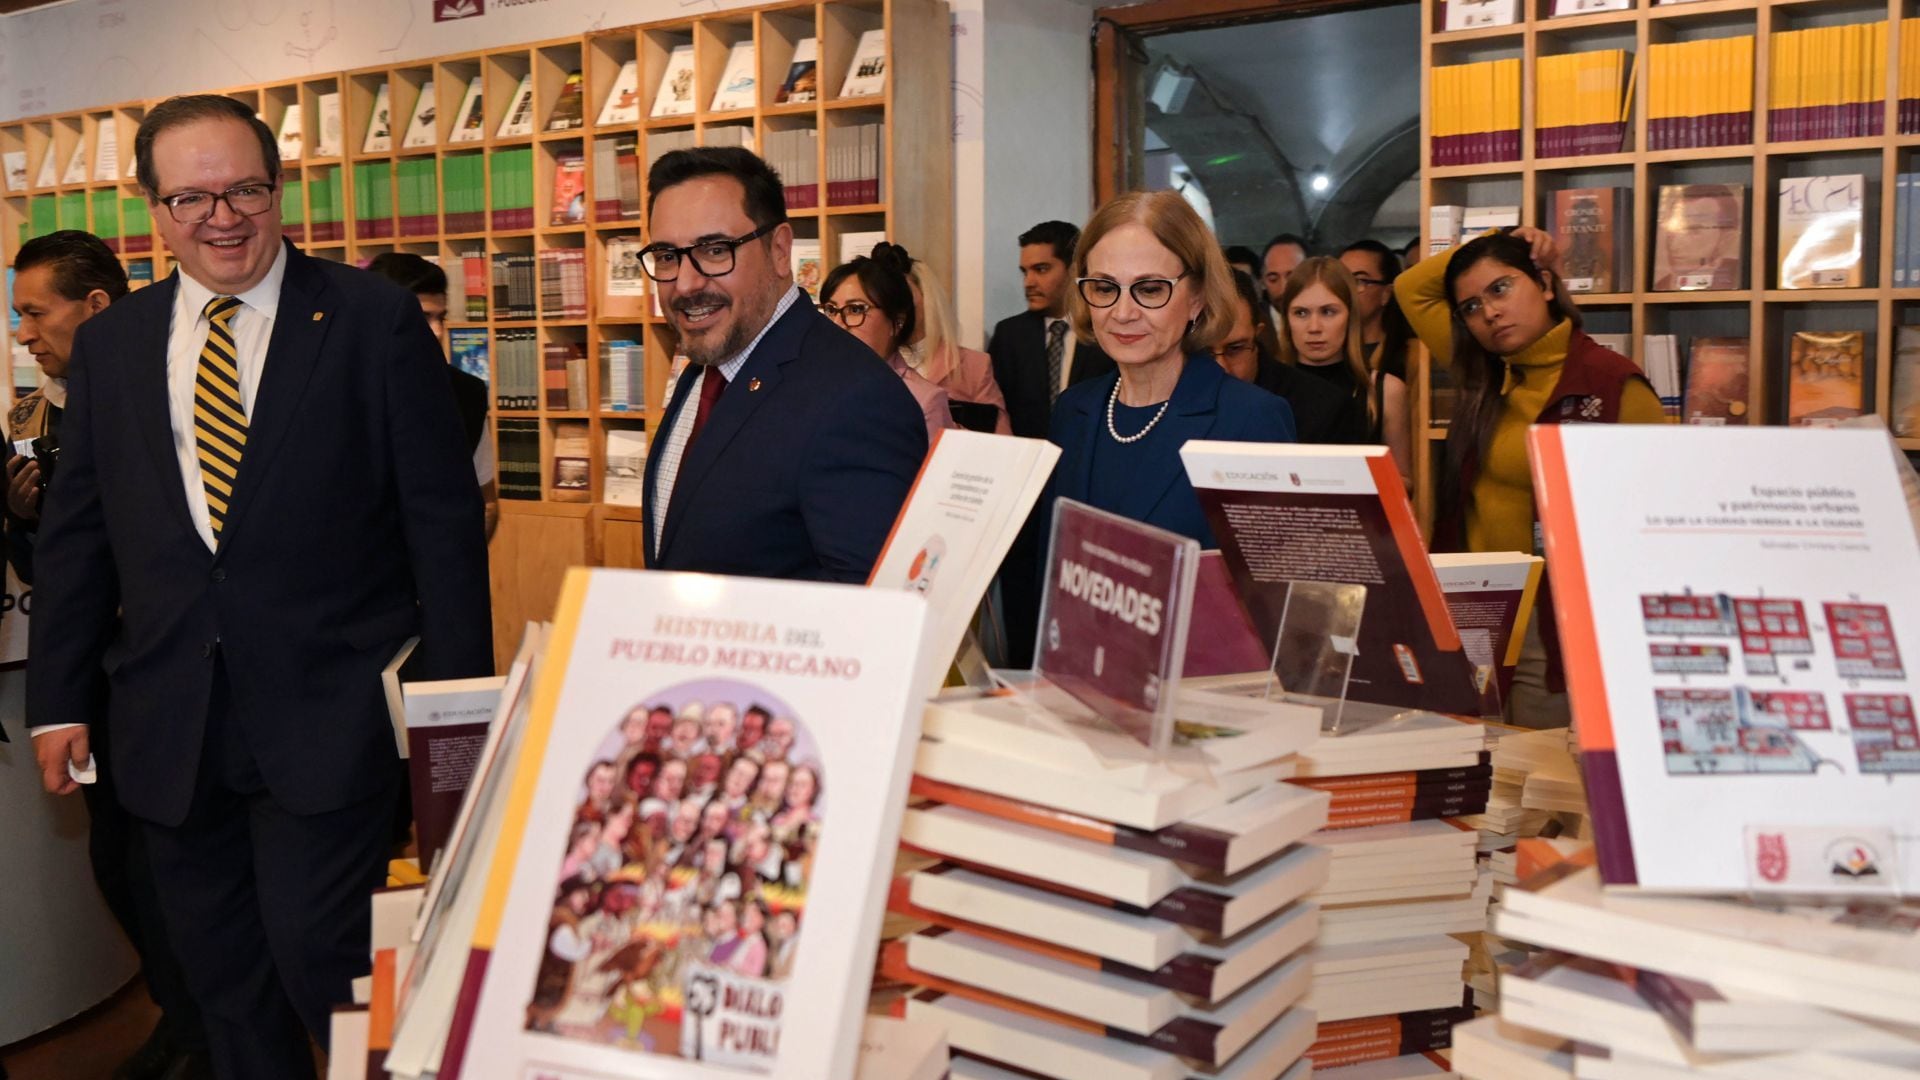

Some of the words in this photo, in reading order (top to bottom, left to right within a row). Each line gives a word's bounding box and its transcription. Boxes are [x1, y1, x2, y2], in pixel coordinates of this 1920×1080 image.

[1059, 558, 1162, 636] NOVEDADES
[653, 614, 778, 644] HISTORIA
[784, 628, 825, 647] DEL
[609, 638, 711, 667] PUEBLO
[713, 647, 863, 681] MEXICANO
